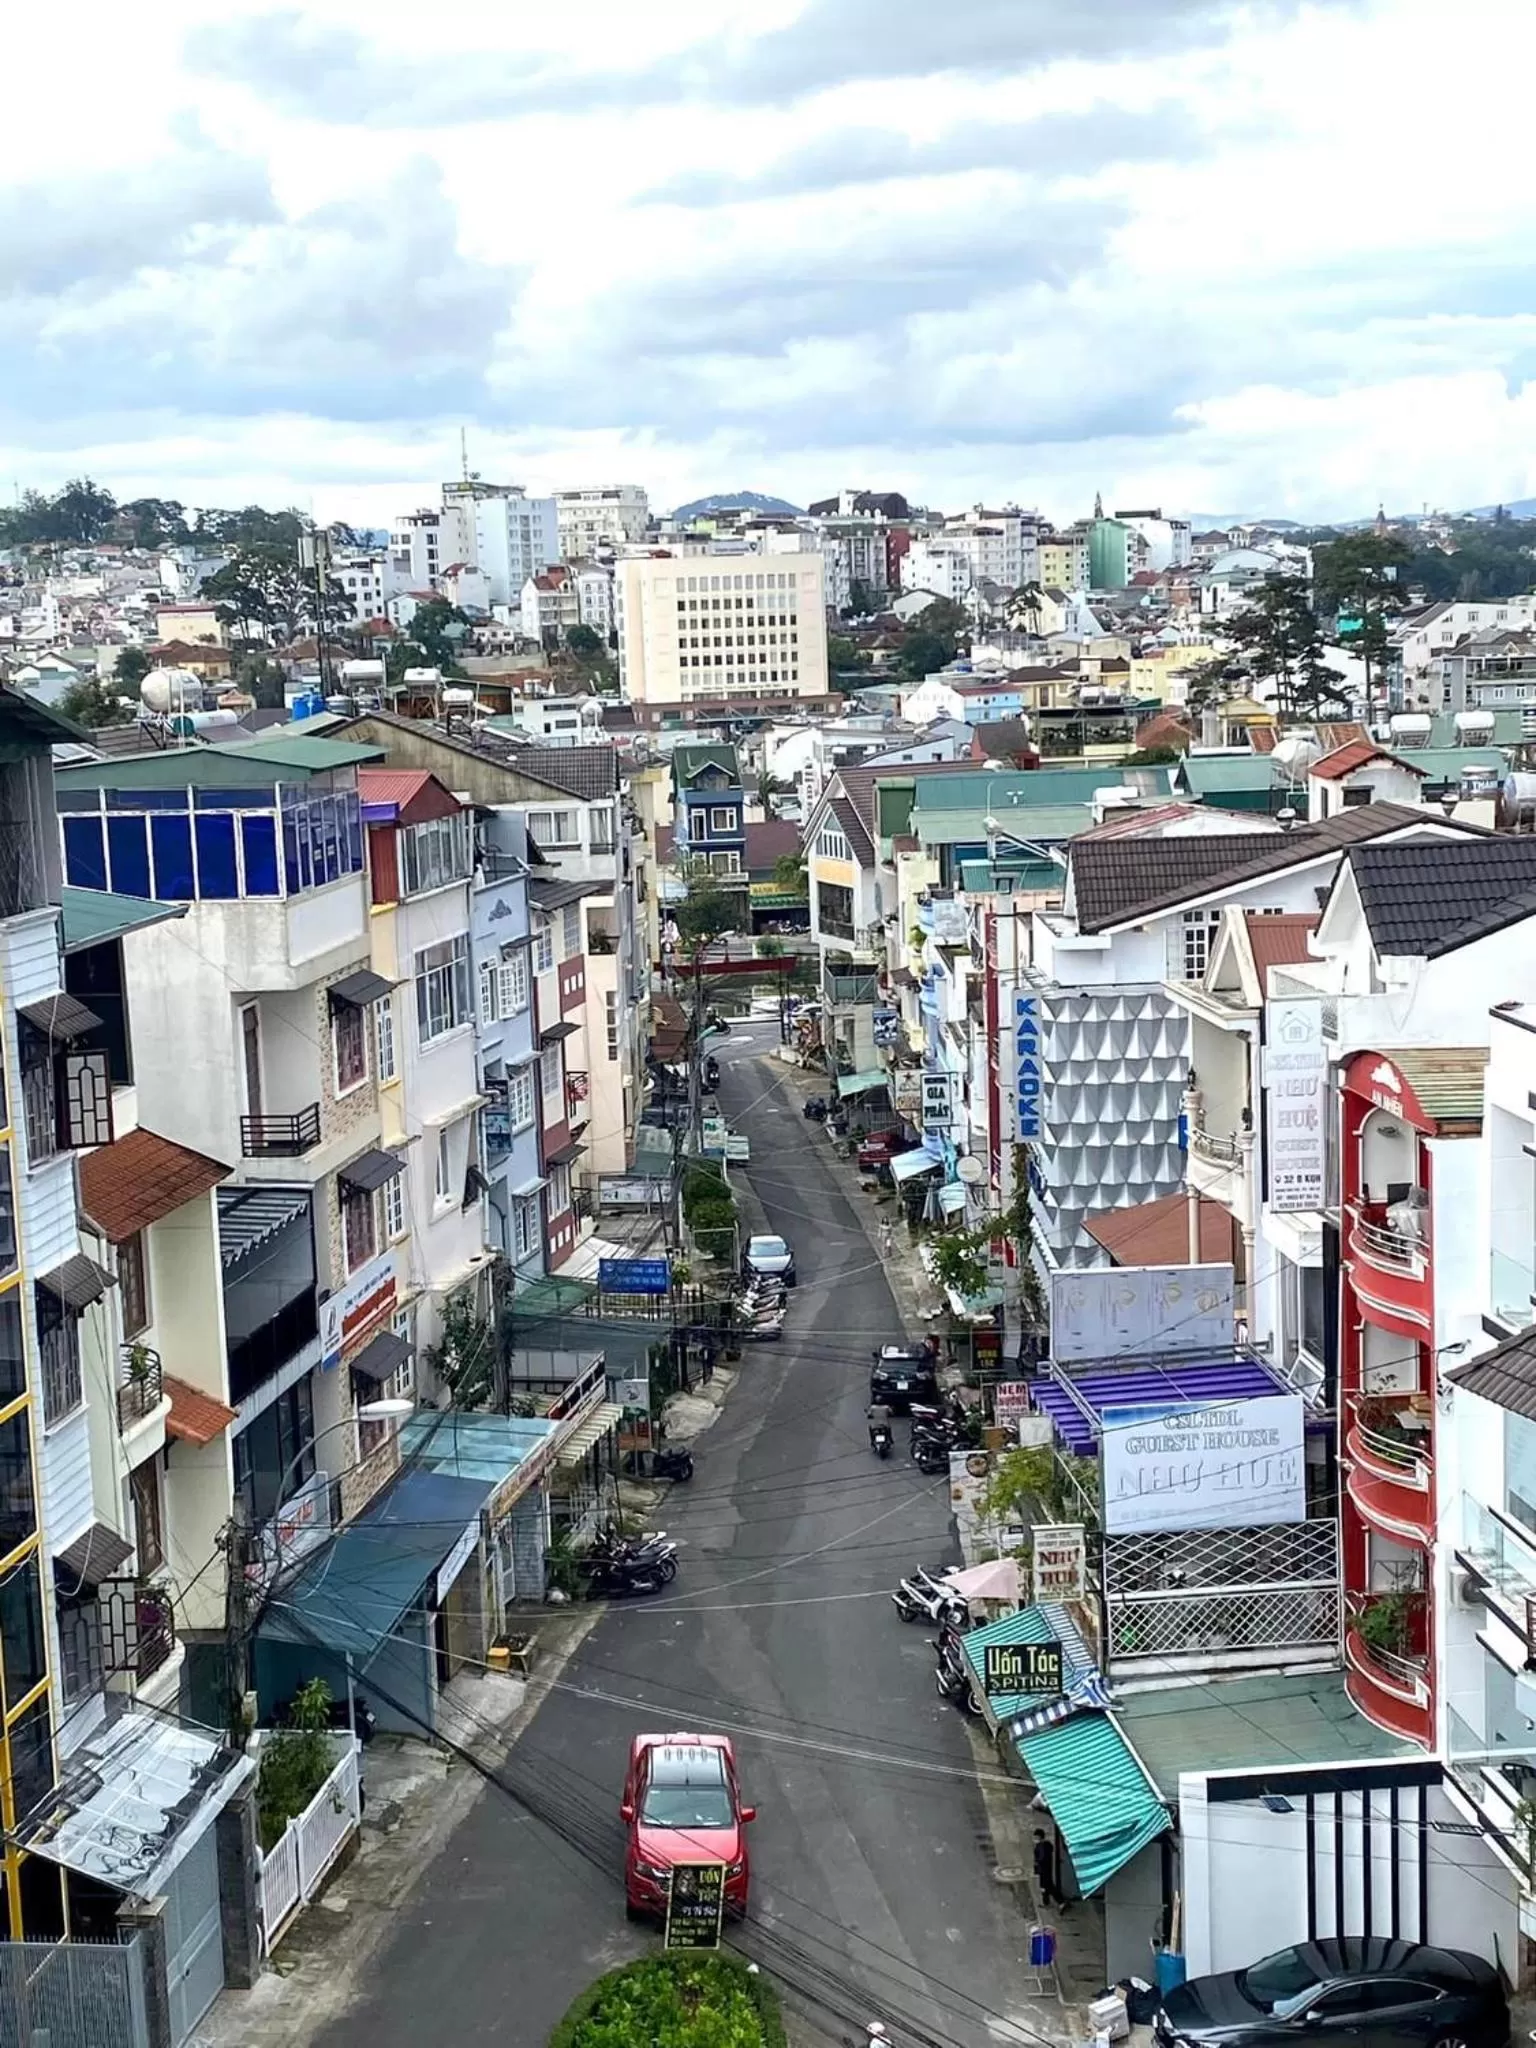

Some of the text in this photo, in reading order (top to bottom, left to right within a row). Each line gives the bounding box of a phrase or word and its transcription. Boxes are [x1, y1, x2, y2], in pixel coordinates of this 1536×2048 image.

[1016, 998, 1040, 1136] KARAOKE
[926, 1086, 946, 1100] GIA
[924, 1102, 950, 1118] PHÁT
[998, 1384, 1027, 1395] NEM
[1125, 1428, 1280, 1455] GUEST HOUSE
[1116, 1458, 1204, 1497] NHƯ
[1038, 1547, 1081, 1566] NHƯ
[988, 1645, 1059, 1675] Uốn Tóc
